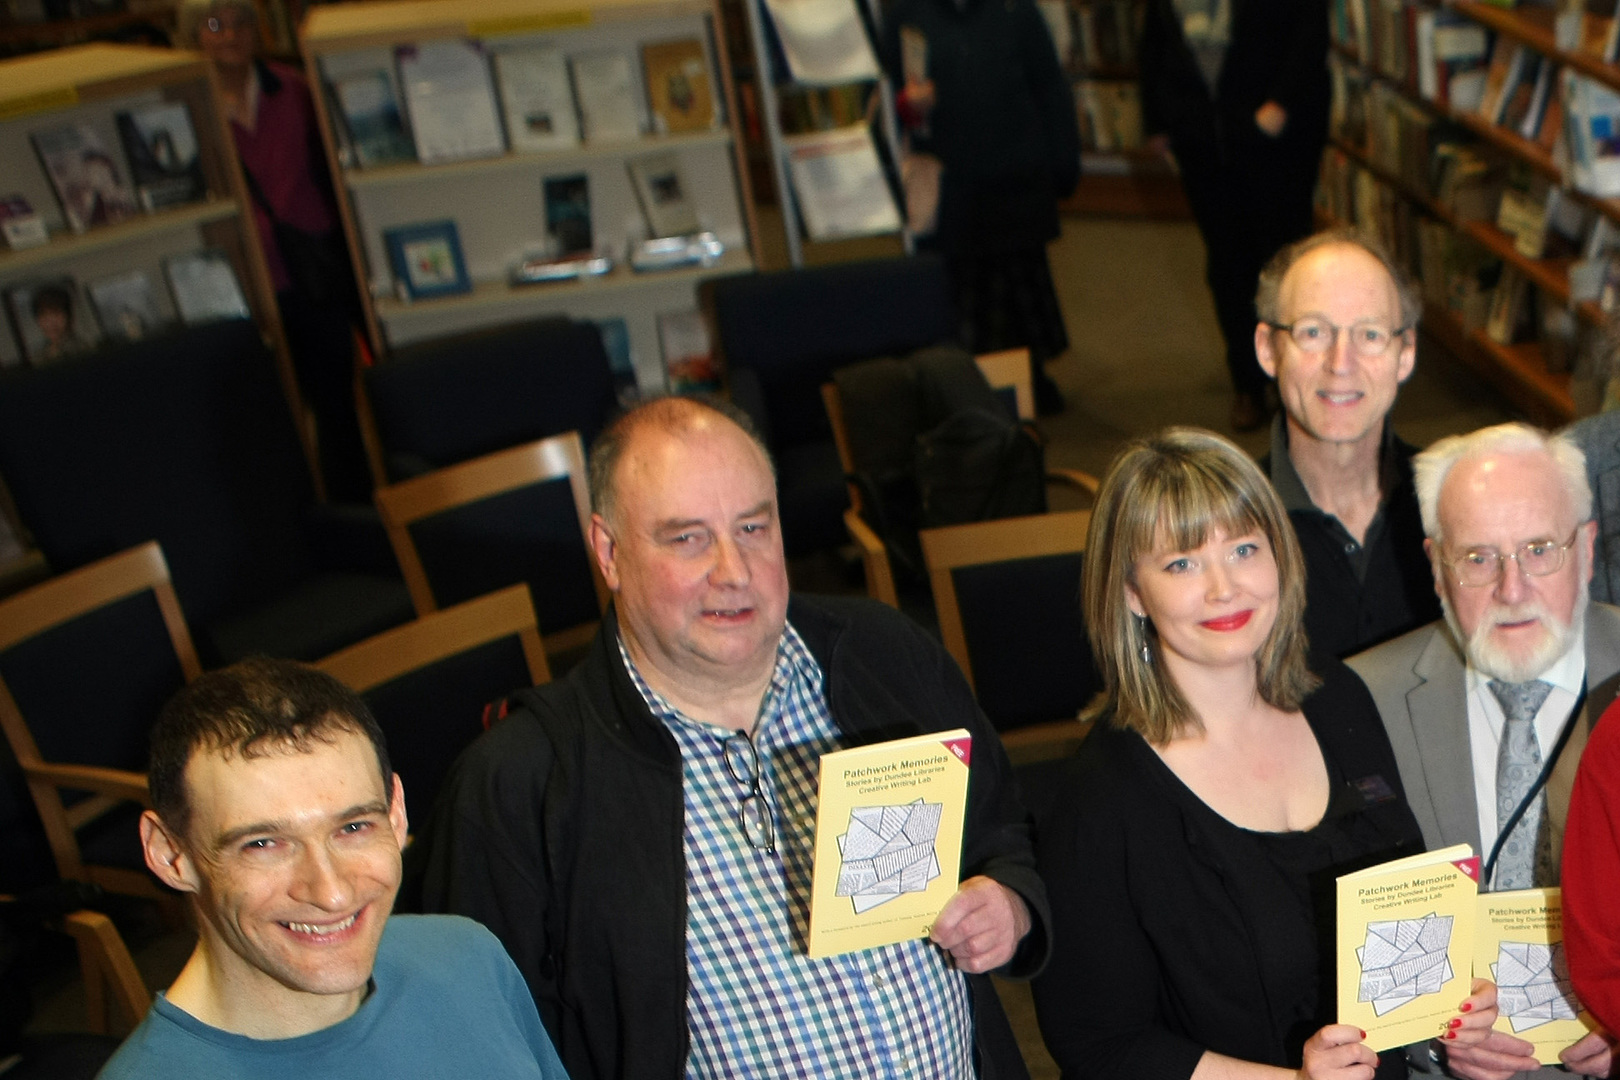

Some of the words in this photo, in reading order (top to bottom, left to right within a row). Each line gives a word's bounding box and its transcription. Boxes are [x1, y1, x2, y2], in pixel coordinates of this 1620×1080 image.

[843, 762, 897, 779] Patchwork
[900, 754, 947, 770] Memories
[1358, 880, 1409, 897] Patchwork
[1412, 872, 1456, 888] Memories
